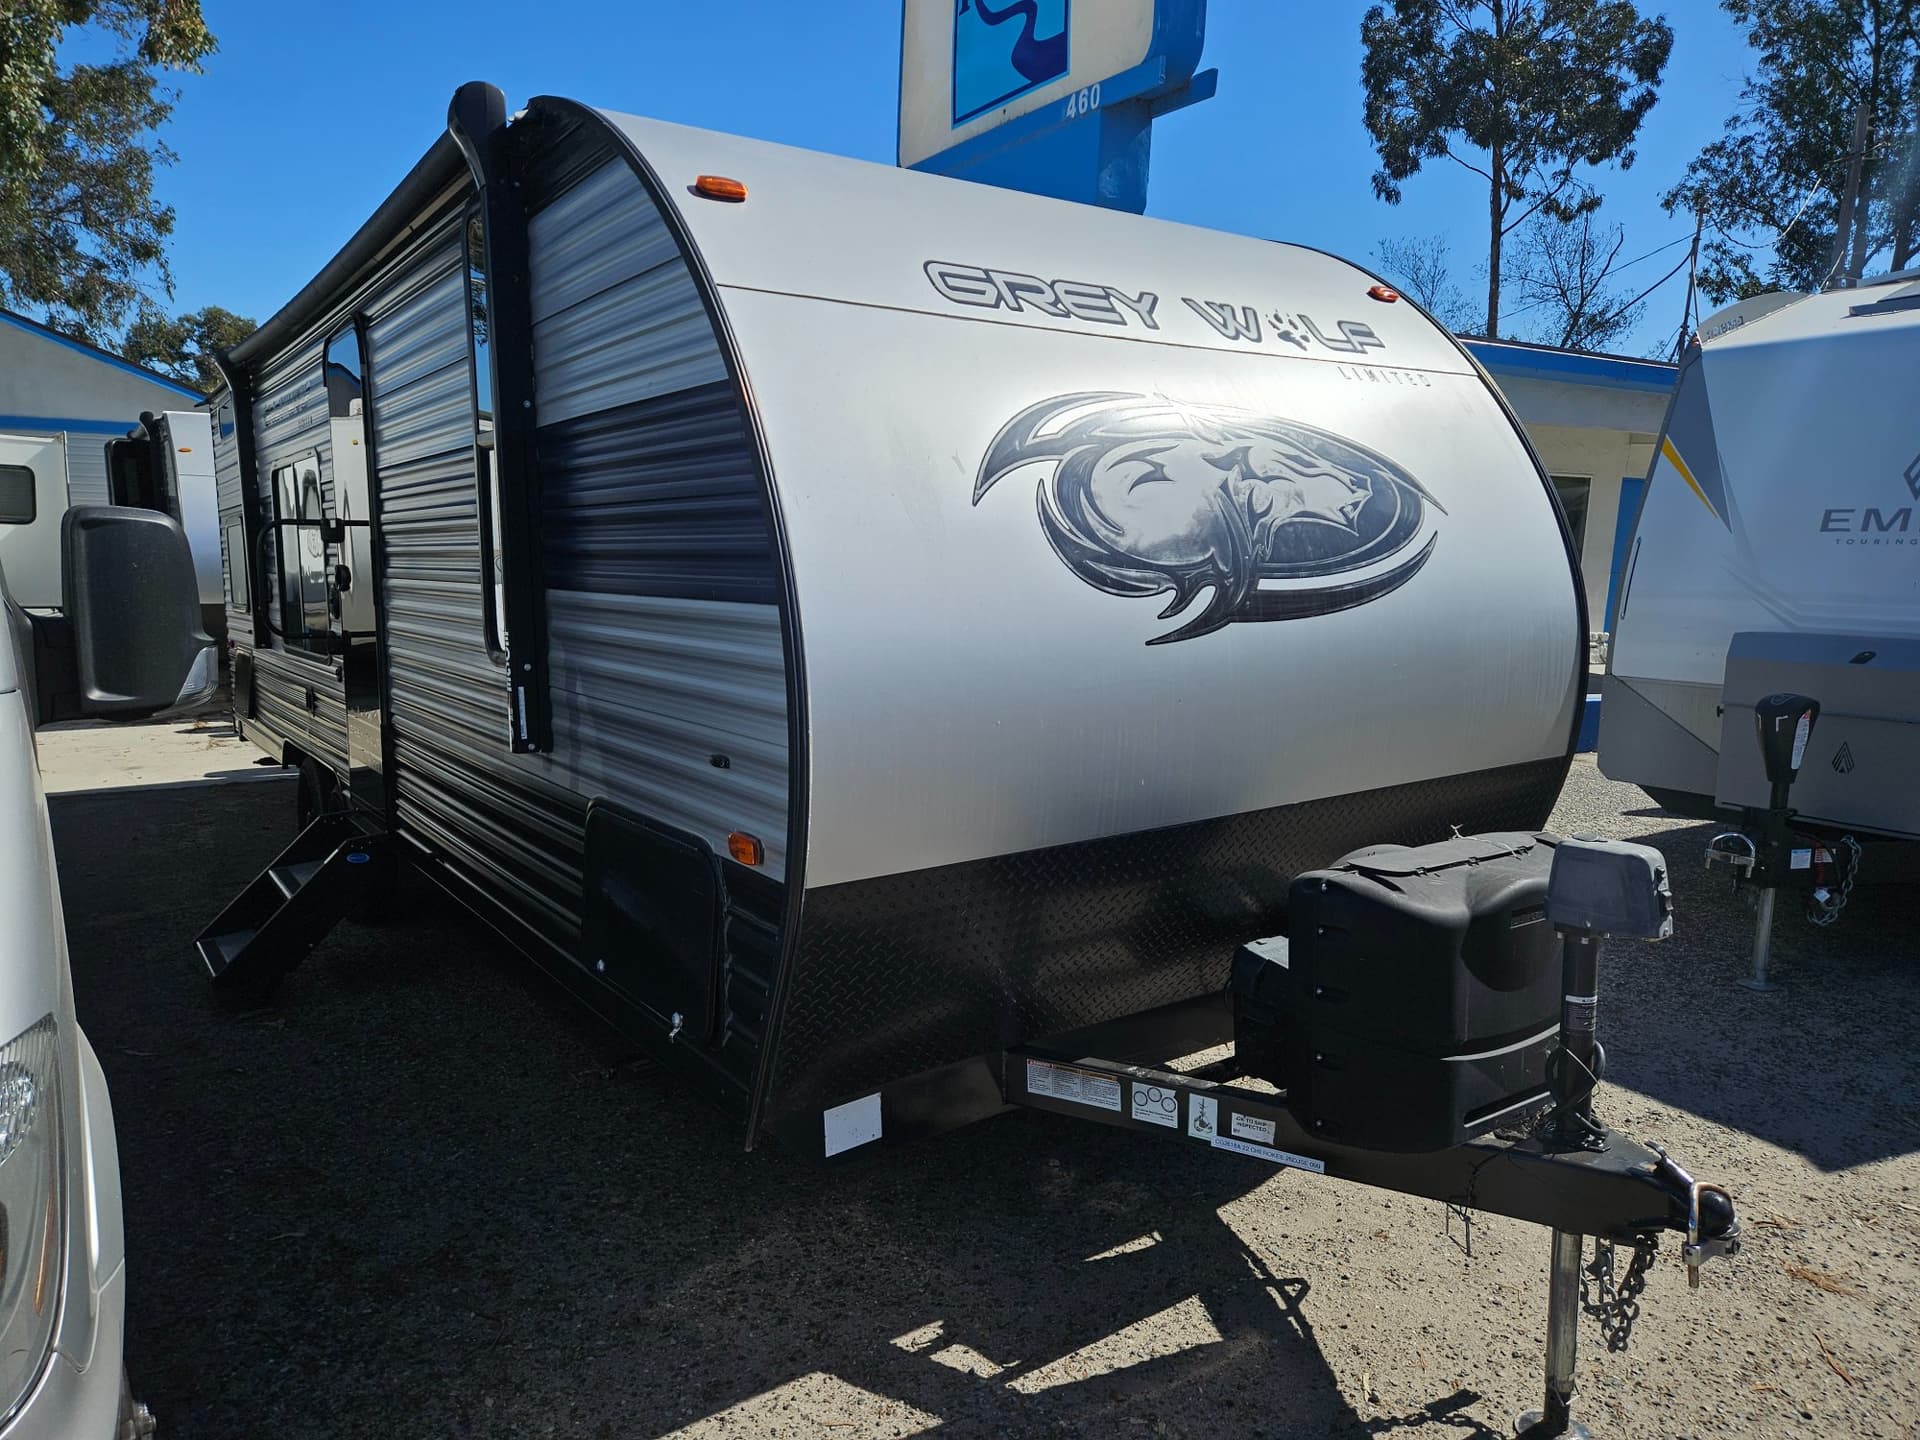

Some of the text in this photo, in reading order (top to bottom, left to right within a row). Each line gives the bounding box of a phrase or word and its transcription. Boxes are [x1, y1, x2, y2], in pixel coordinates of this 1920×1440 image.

[1066, 84, 1100, 118] 460
[923, 259, 1161, 330] GREY
[1337, 366, 1431, 387] LIMITED
[1819, 508, 1920, 532] EM
